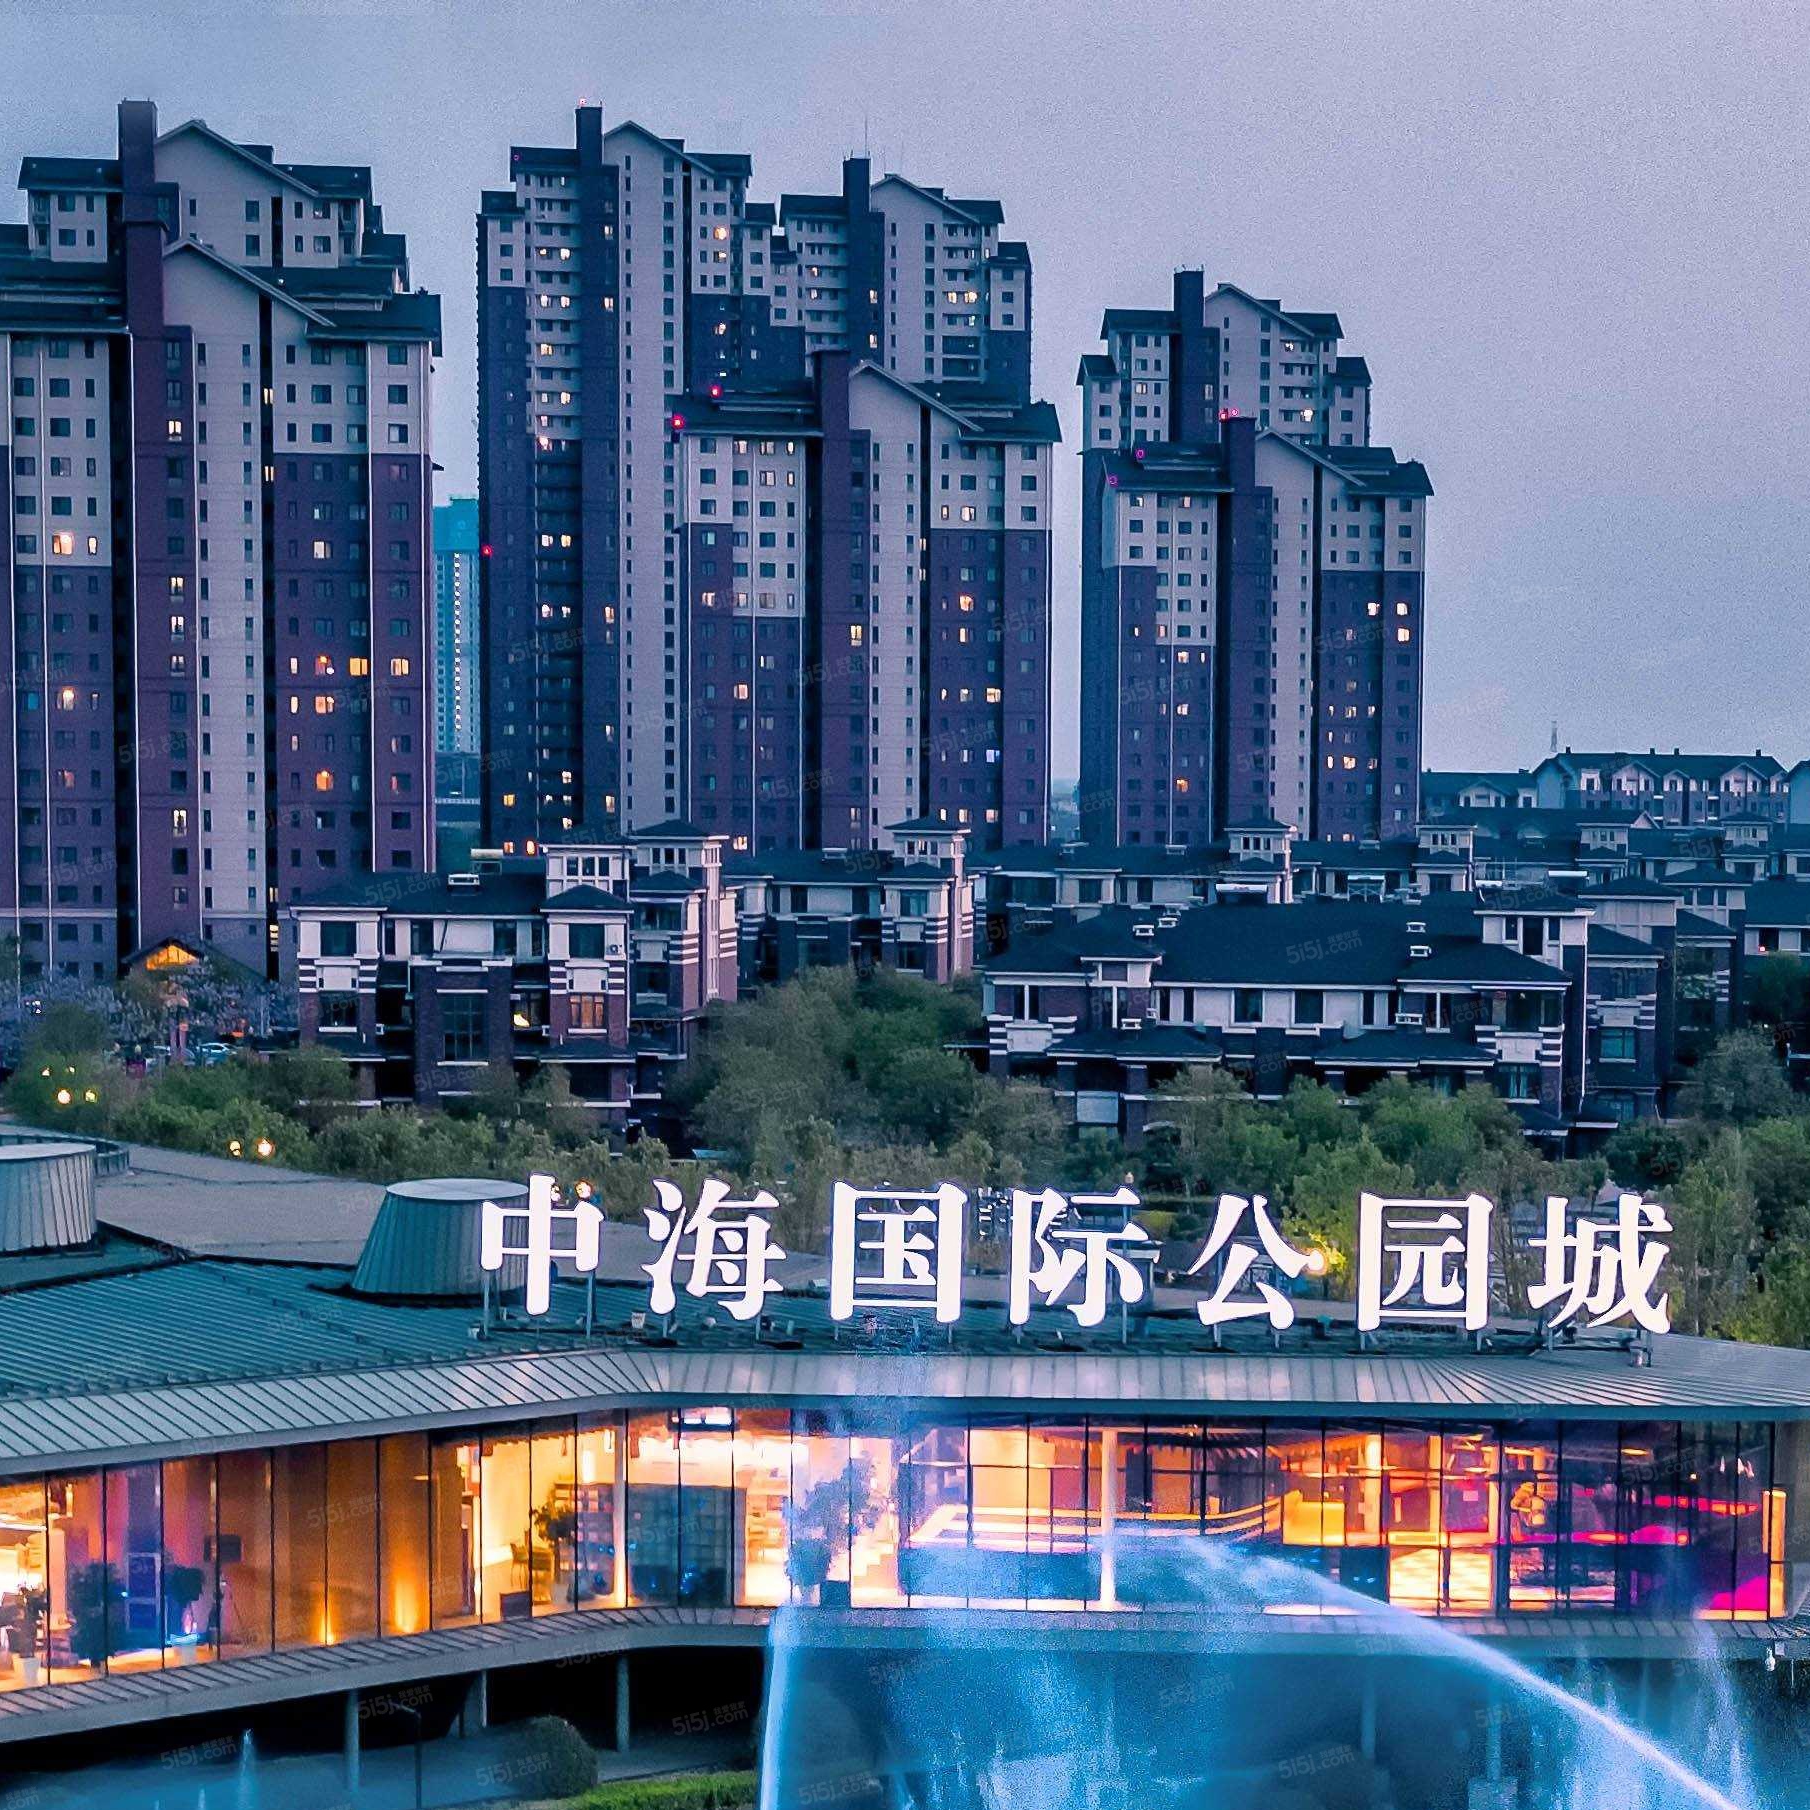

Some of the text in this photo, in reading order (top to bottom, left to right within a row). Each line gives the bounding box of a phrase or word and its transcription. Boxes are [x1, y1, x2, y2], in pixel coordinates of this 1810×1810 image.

[480, 1172, 1673, 1333] 中海国际公园城
